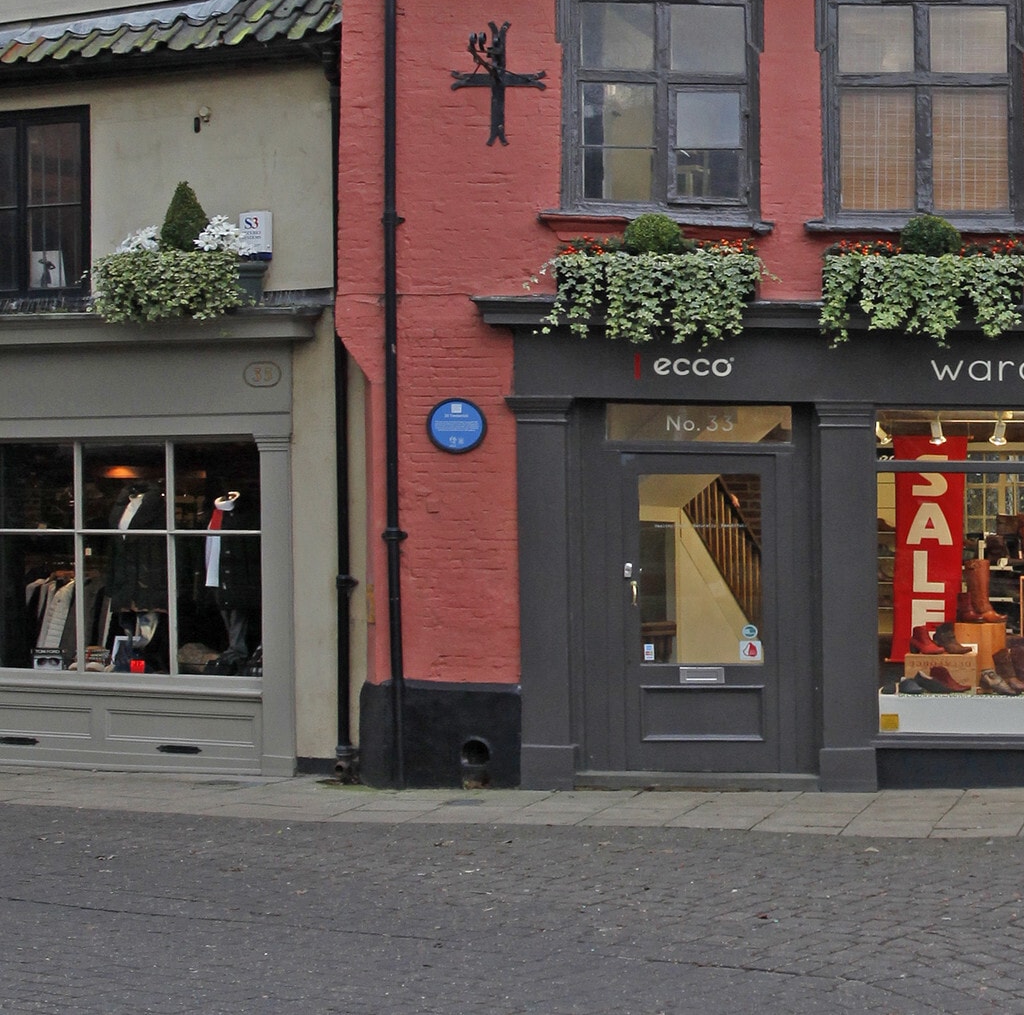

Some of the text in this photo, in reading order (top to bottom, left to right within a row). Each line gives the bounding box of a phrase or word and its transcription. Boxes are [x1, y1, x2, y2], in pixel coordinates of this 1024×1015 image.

[244, 216, 259, 230] S3
[653, 357, 733, 377] ecco
[666, 415, 734, 432] No. 33
[906, 454, 953, 639] SALE
